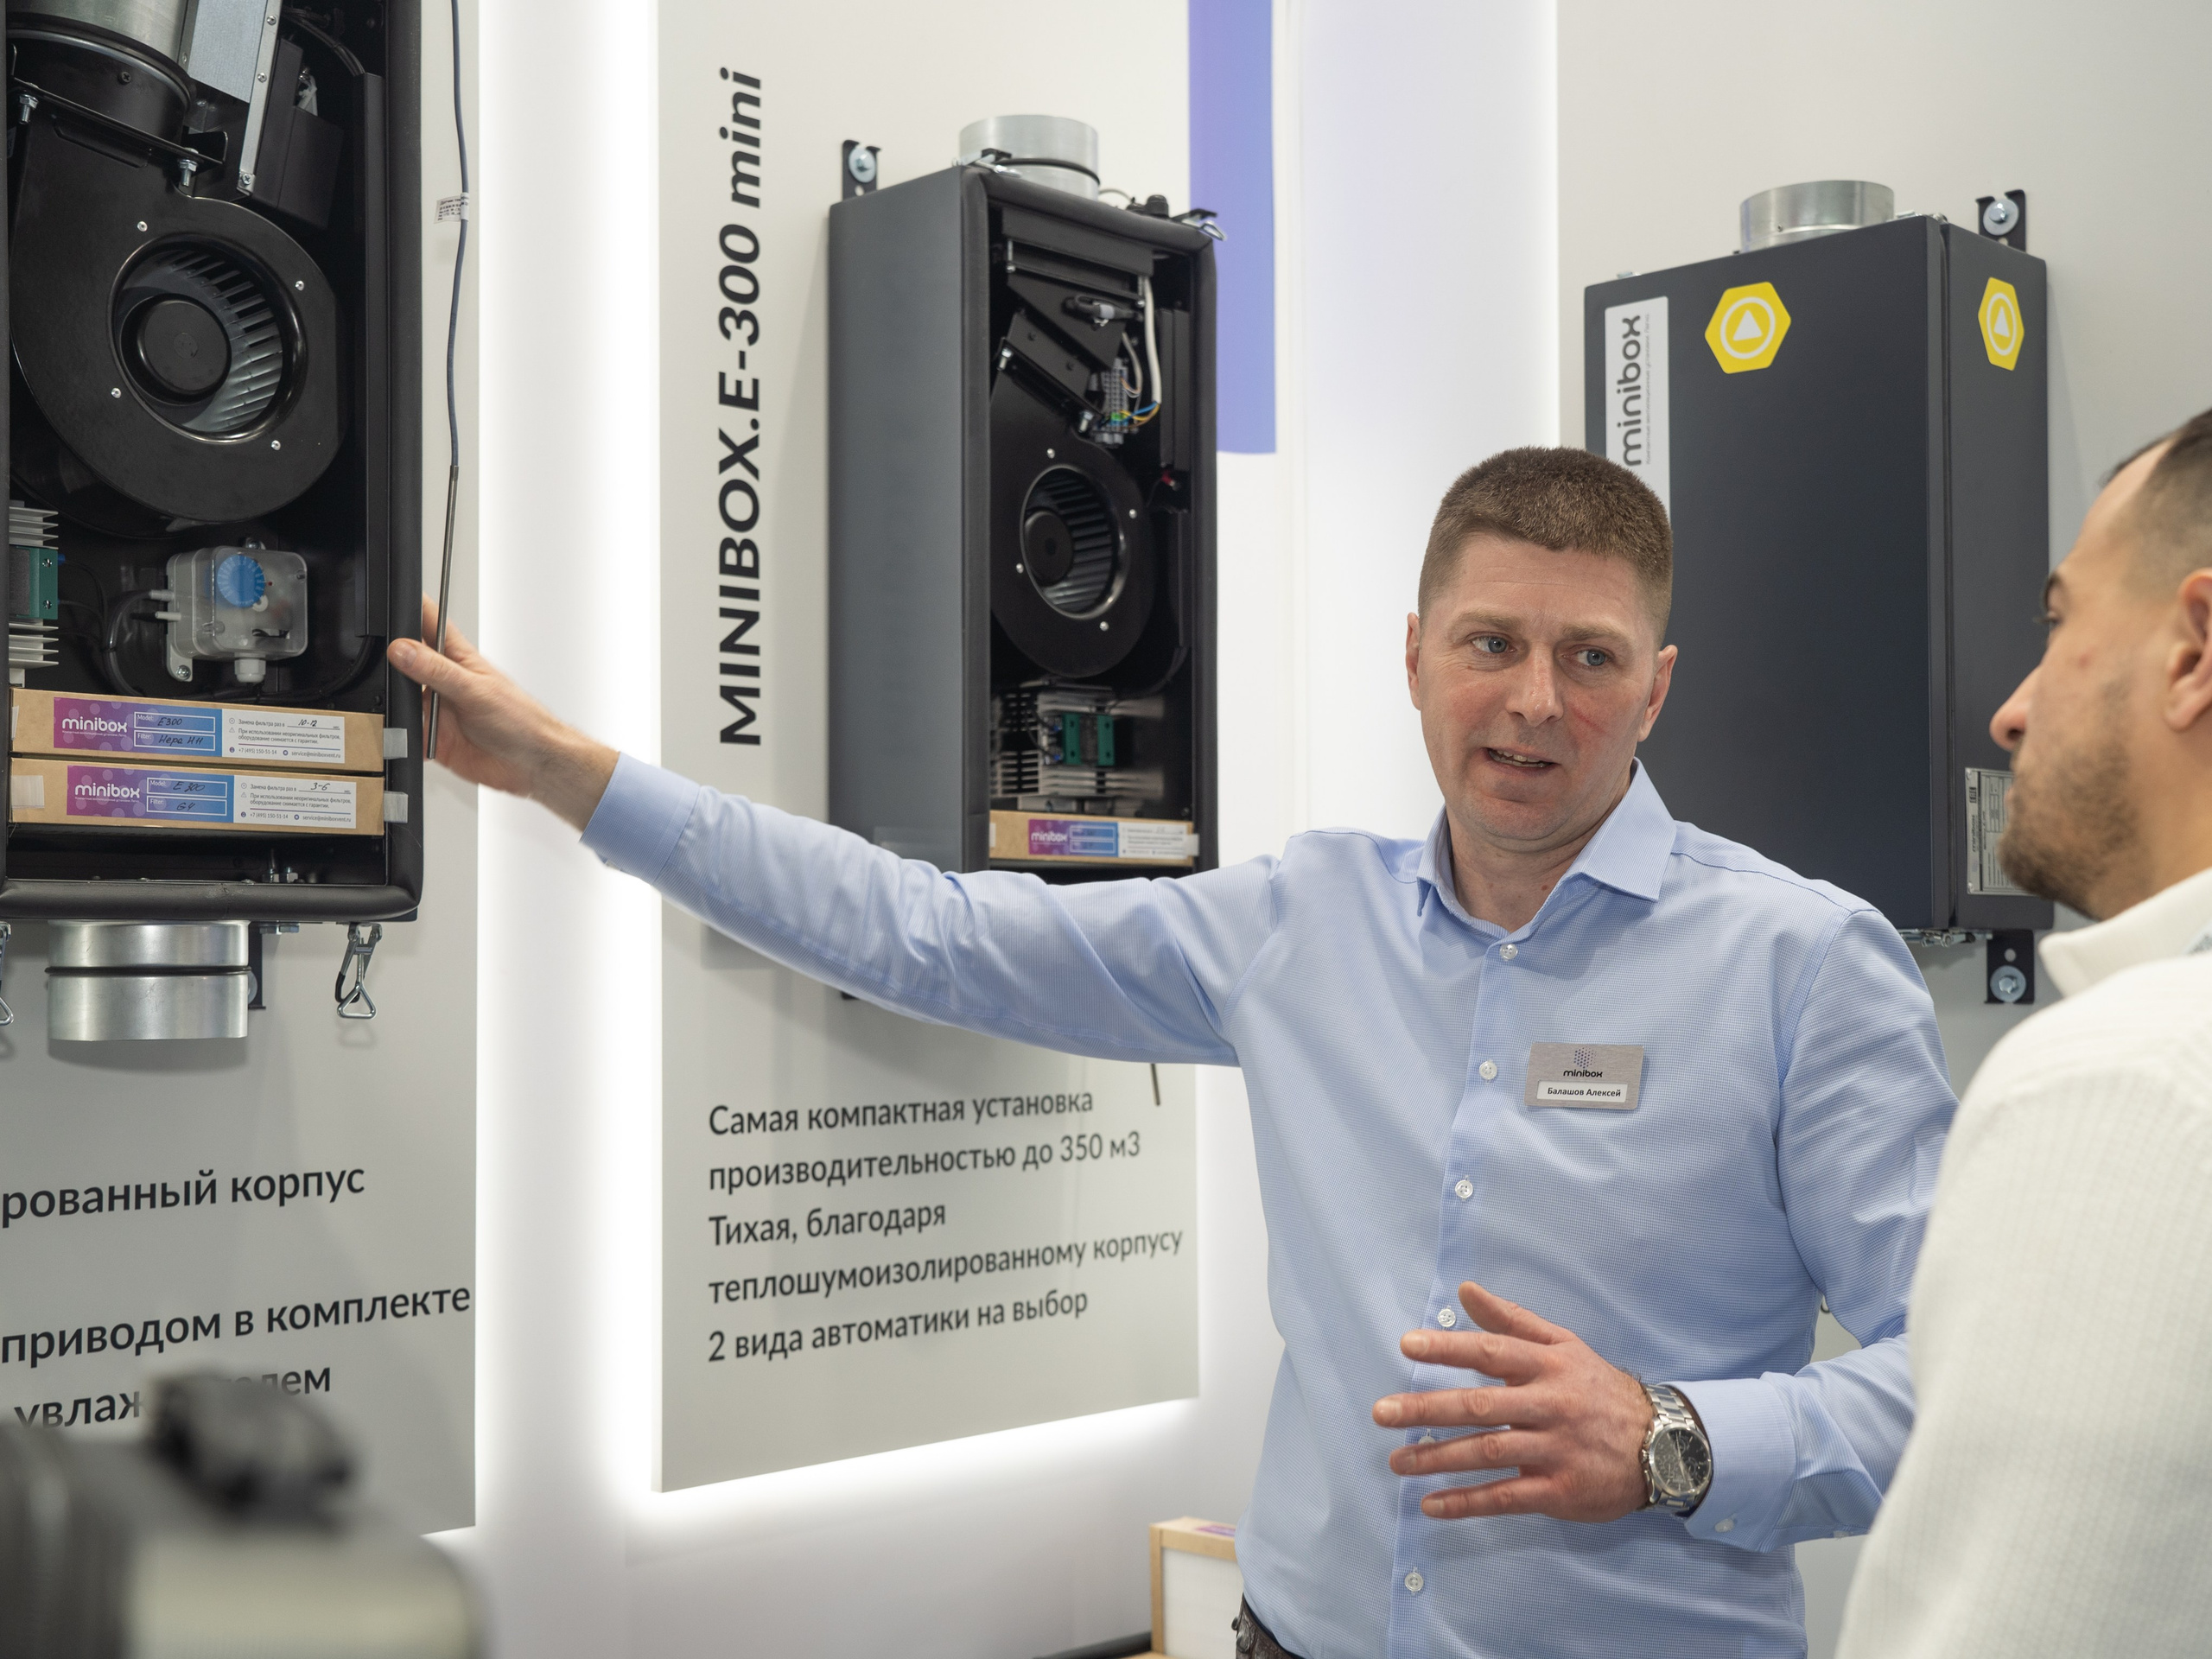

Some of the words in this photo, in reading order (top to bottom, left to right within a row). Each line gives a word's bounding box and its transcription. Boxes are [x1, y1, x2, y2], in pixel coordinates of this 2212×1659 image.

[718, 67, 762, 209] mini
[1617, 315, 1642, 467] minibox
[717, 223, 762, 747] MINIBOX.E-300
[62, 716, 127, 733] minibox
[157, 717, 183, 726] E300
[75, 783, 140, 798] minibox
[311, 782, 330, 791] 3-6
[1030, 831, 1069, 843] minibox
[1548, 1087, 1585, 1096] Балашов
[1586, 1088, 1621, 1097] Алексей
[1563, 1069, 1603, 1077] minibox
[709, 1104, 798, 1136] Самая
[808, 1099, 964, 1130] компактная
[972, 1091, 1093, 1124] установка
[709, 1146, 1016, 1196] производительностью
[1022, 1145, 1053, 1171] до
[1060, 1133, 1103, 1162] 350
[1110, 1130, 1141, 1159] м3
[2, 1168, 217, 1229] рованный
[231, 1168, 365, 1208] корпус
[708, 1214, 798, 1247] Тихая,
[806, 1204, 946, 1237] благодаря
[708, 1242, 1086, 1305] теплошумоизолированному
[1093, 1230, 1183, 1262] корпусу
[2, 1313, 220, 1369] приводом
[235, 1310, 254, 1337] в
[267, 1287, 471, 1333] комплекте
[708, 1330, 726, 1363] 2
[735, 1329, 803, 1361] вида
[811, 1307, 969, 1350] автоматики
[977, 1303, 1005, 1326] на
[1013, 1289, 1088, 1322] выбор
